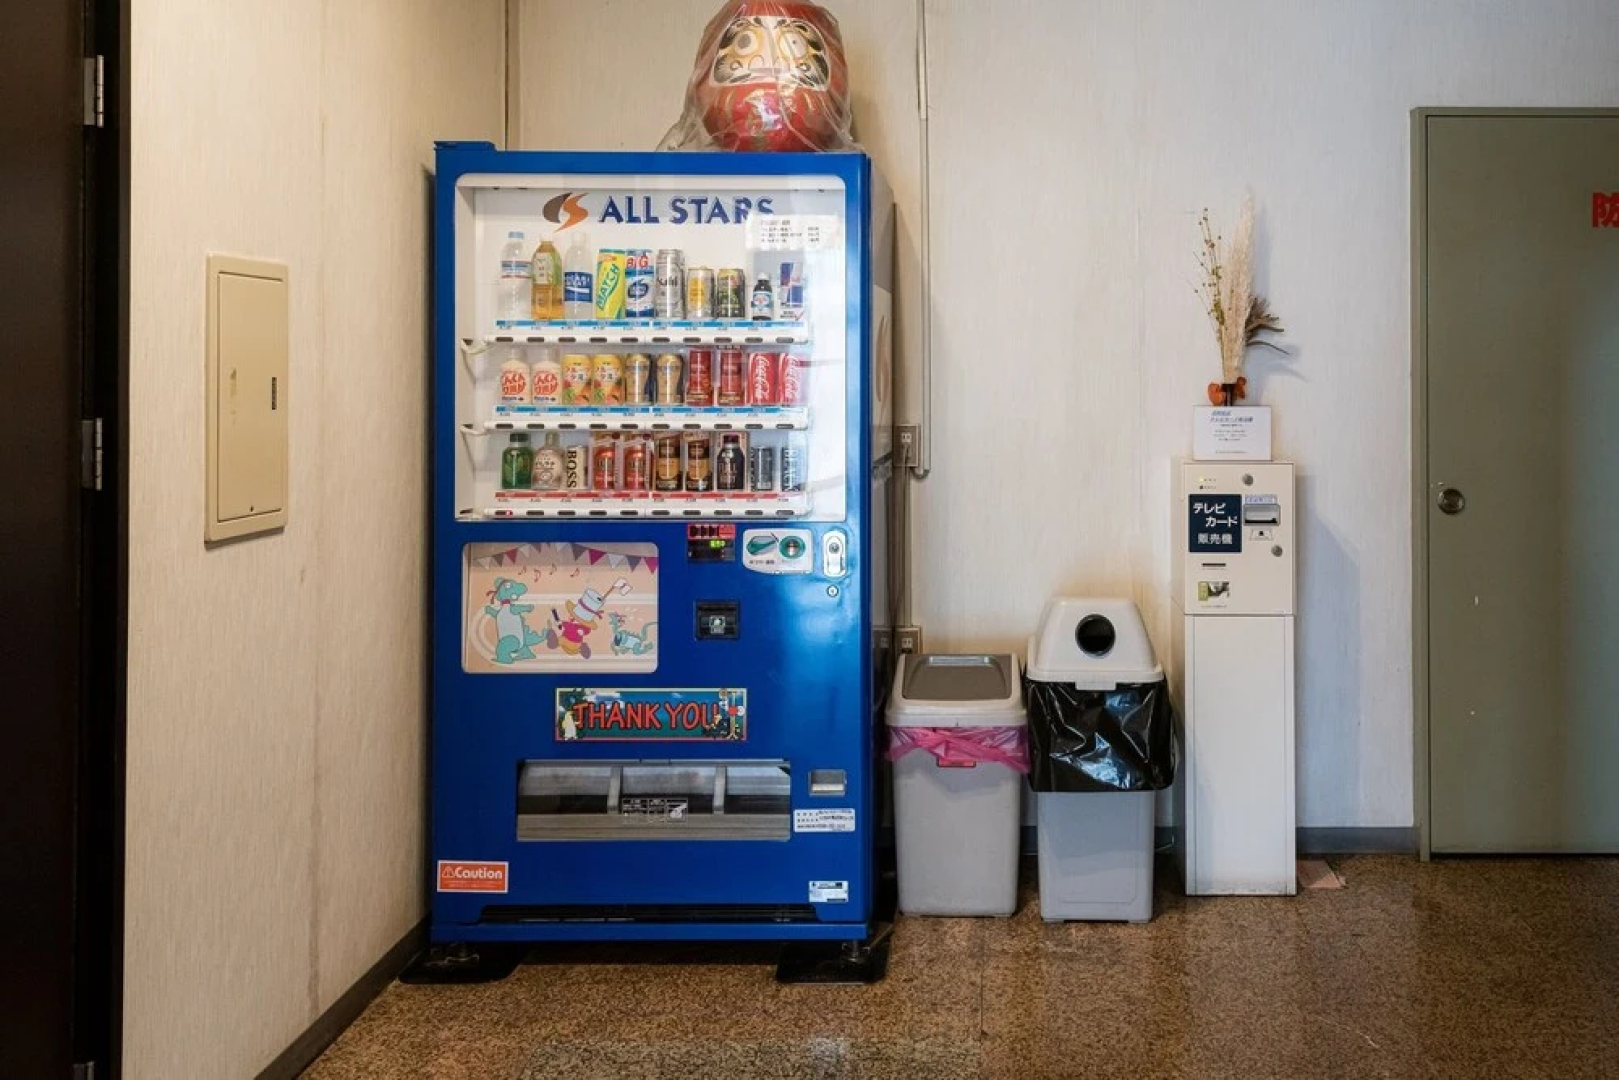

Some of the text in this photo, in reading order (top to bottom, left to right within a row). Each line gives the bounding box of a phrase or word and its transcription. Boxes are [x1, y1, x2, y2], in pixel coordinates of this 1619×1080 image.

[598, 195, 774, 225] ALL STARS
[566, 450, 578, 488] BOSS
[1192, 502, 1226, 515] テレビ
[1205, 516, 1238, 528] カード
[1197, 533, 1233, 545] 販売機
[573, 701, 719, 730] THANK YOU
[455, 865, 503, 879] Caution
